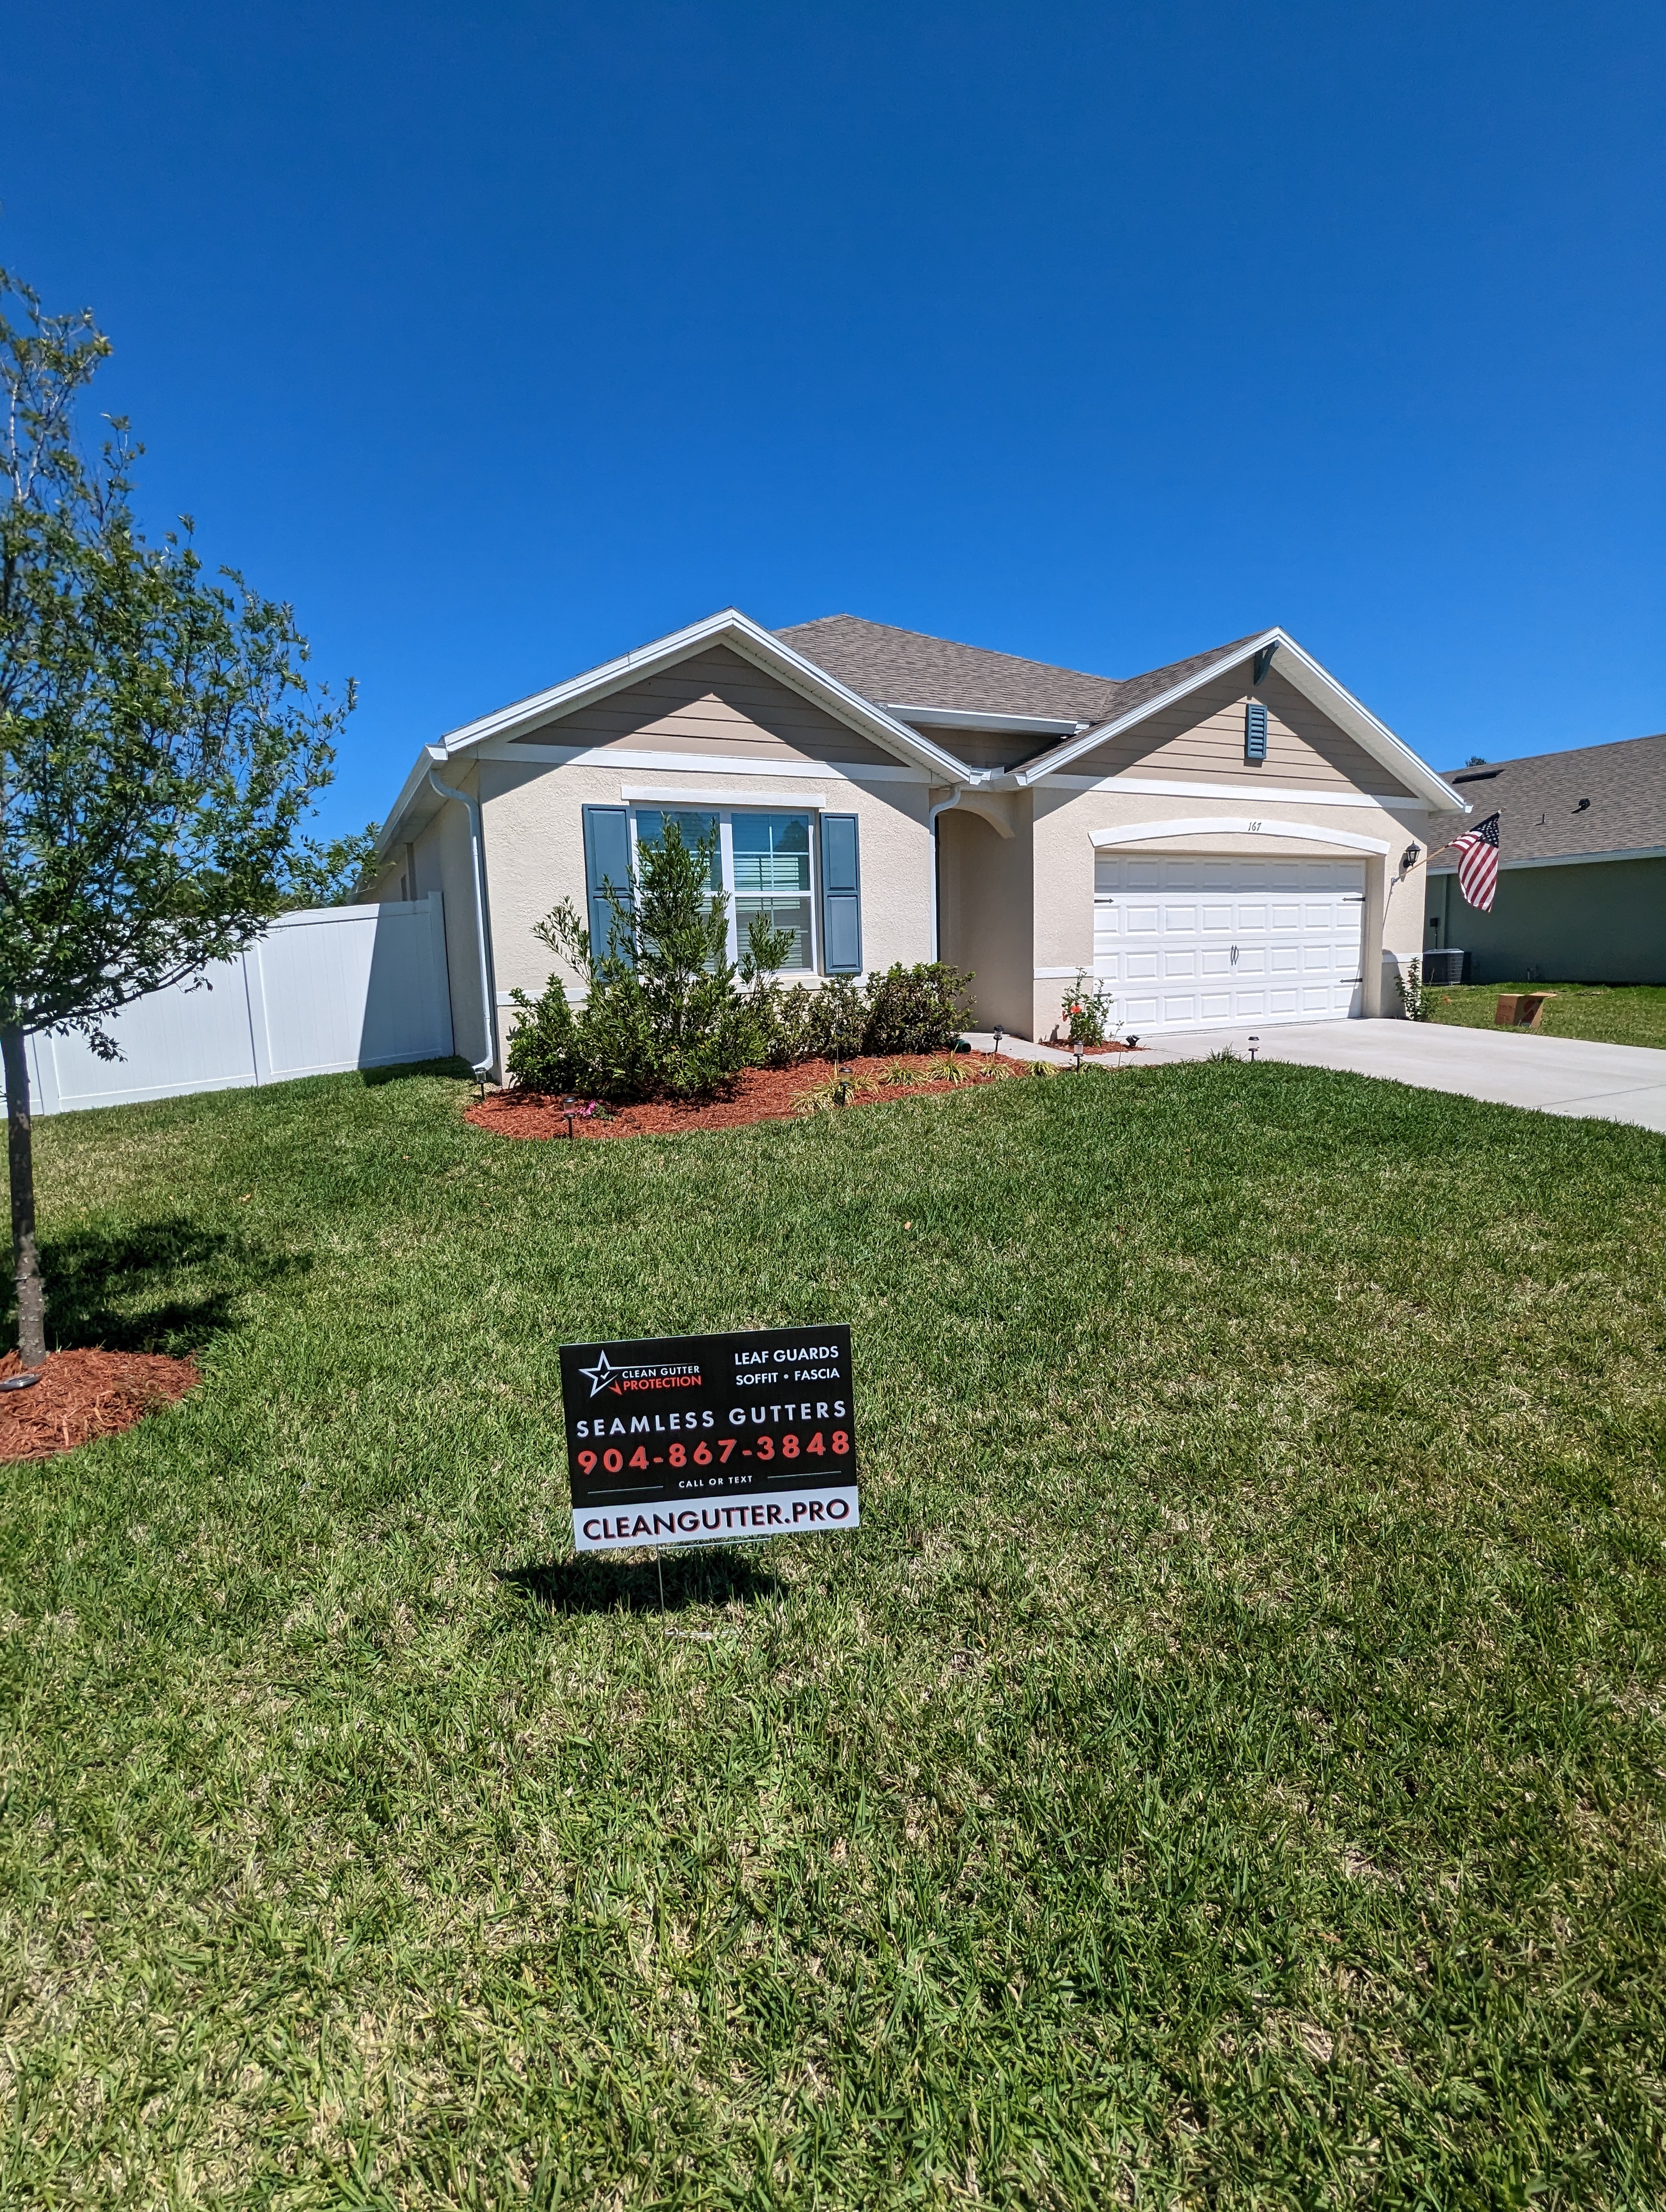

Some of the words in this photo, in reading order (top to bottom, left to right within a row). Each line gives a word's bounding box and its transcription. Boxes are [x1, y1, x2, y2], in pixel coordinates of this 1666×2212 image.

[1248, 821, 1262, 832] 167
[735, 1351, 769, 1365] LEAF
[773, 1346, 839, 1362] GUARDS
[622, 1369, 656, 1379] CLEAN
[661, 1366, 700, 1376] GUTTER
[736, 1372, 779, 1386] SOFFIT
[794, 1368, 840, 1381] FASCIA
[623, 1375, 702, 1391] PROTECTION
[576, 1411, 715, 1437] SEAMLESS
[728, 1400, 846, 1425] GUTTERS
[578, 1430, 850, 1475] 904-867-3848
[678, 1479, 704, 1488] CALL
[728, 1475, 753, 1484] TEXT
[582, 1498, 850, 1540] CLEANGUTTER.PRO
